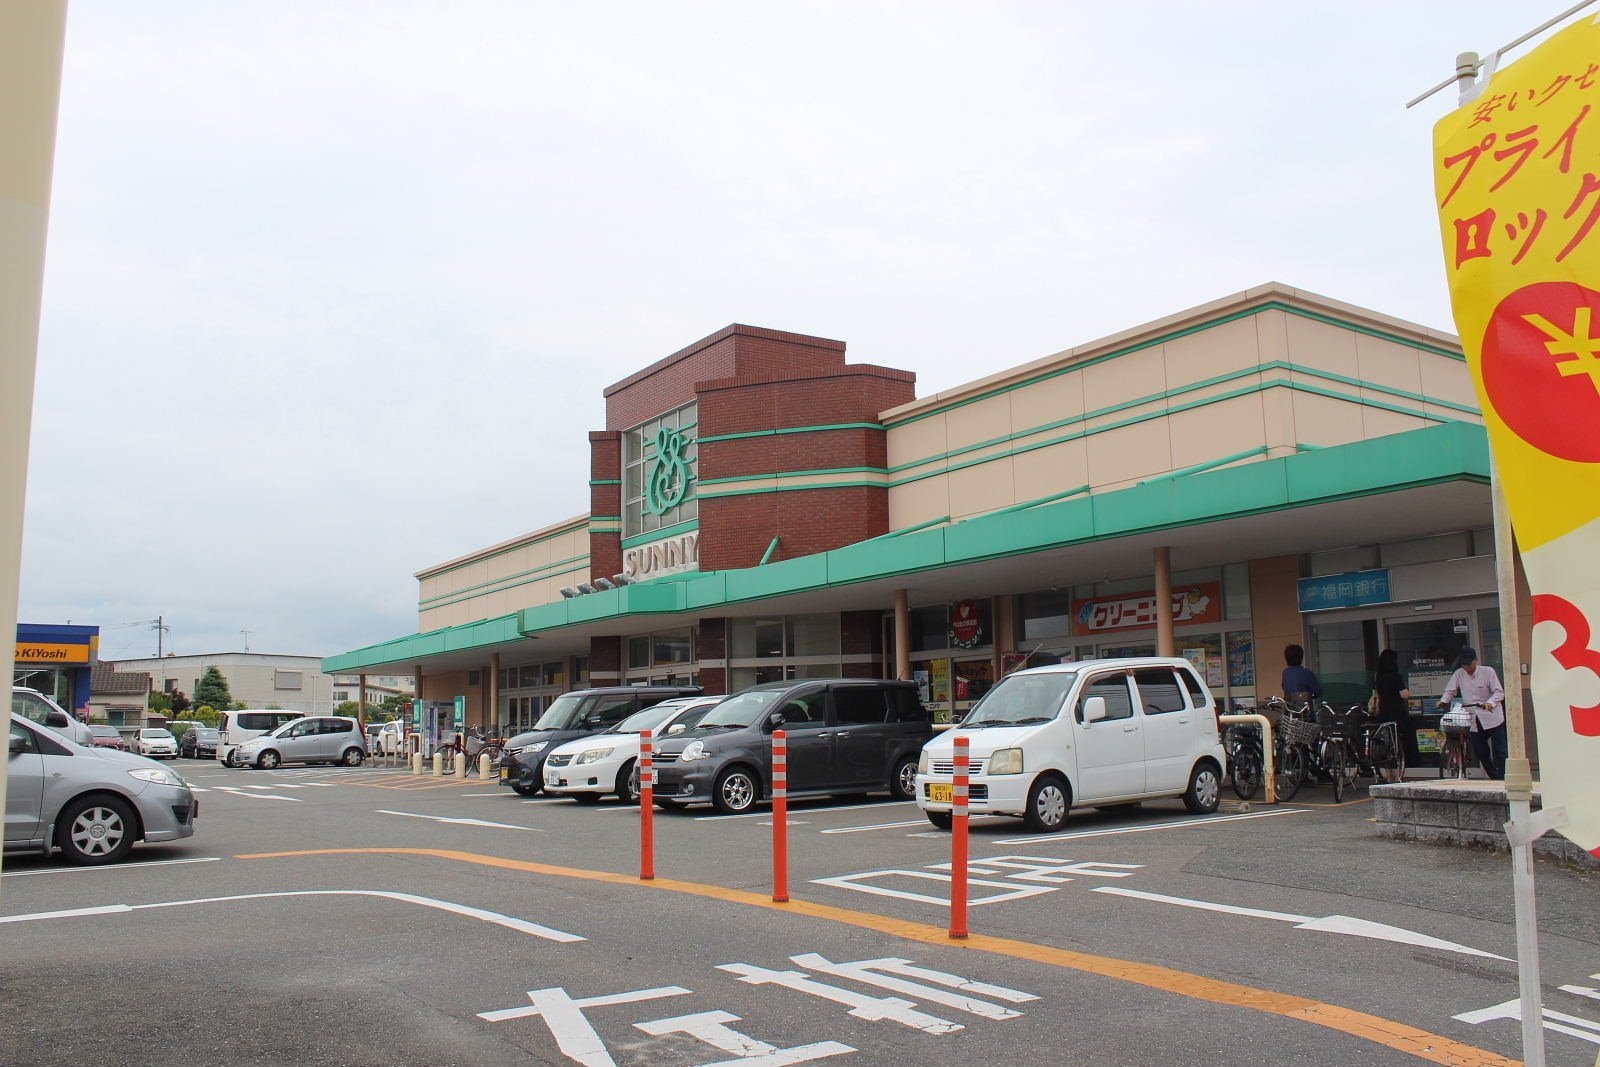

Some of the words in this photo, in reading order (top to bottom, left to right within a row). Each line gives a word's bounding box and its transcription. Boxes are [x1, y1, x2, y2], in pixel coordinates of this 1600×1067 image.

[626, 534, 700, 577] SUNNY
[1321, 578, 1386, 600] 福岡銀行
[21, 648, 68, 659] KiYoshi
